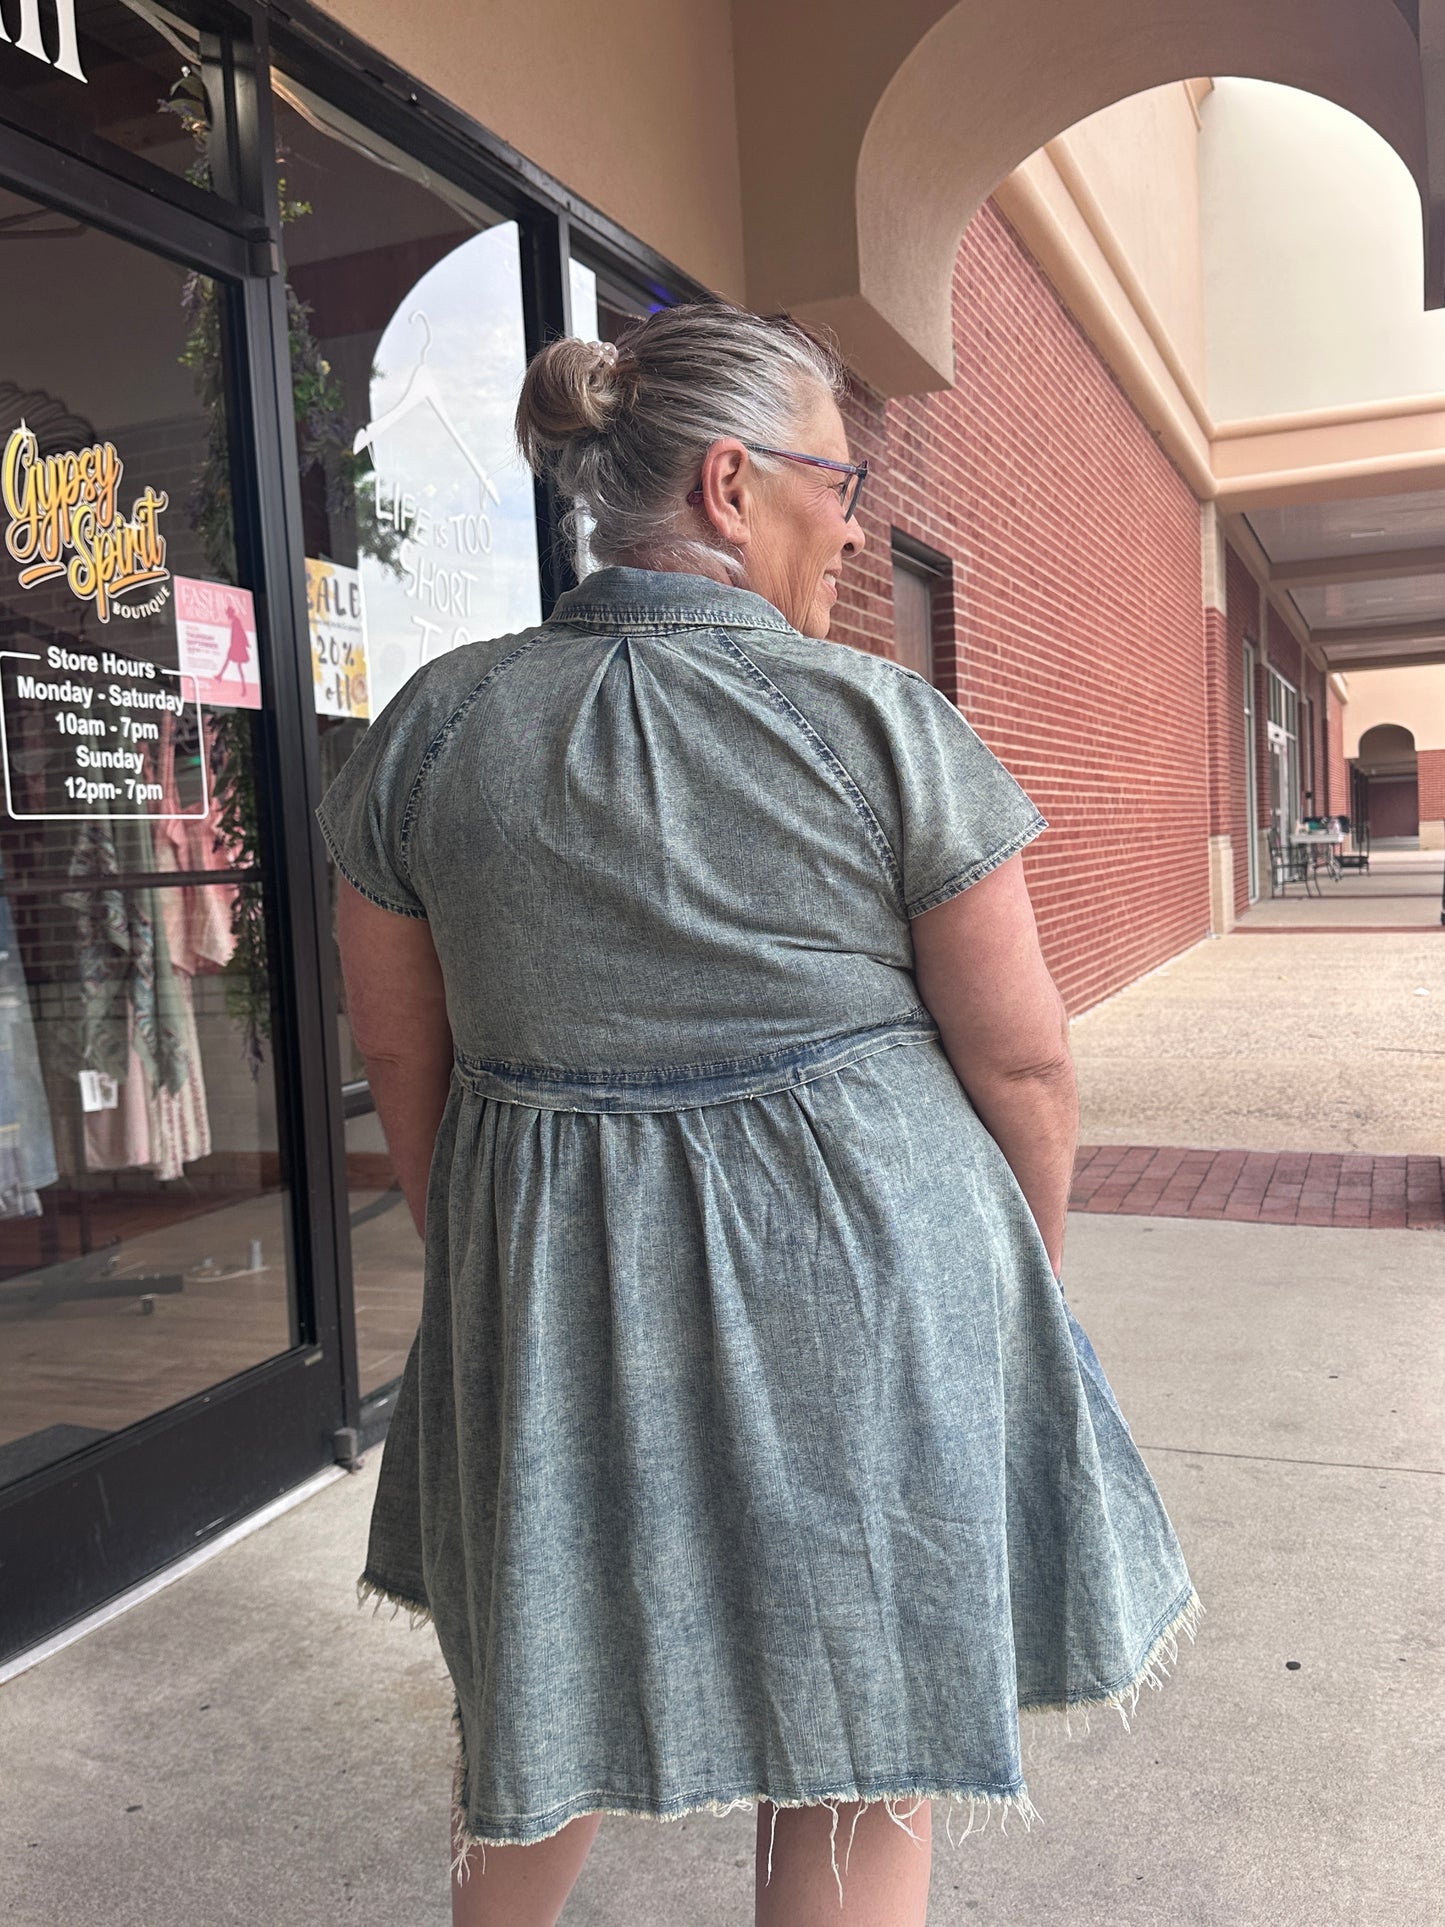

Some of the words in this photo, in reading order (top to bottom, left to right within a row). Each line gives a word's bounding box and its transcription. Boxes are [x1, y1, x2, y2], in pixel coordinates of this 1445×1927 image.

[2, 417, 124, 563] Gypsy
[375, 475, 431, 548] LIFE
[431, 522, 449, 549] IS
[448, 513, 493, 555] TOO
[67, 485, 169, 624] Spirit
[399, 538, 479, 617] SHORT
[112, 585, 172, 619] BOUTIQUE
[47, 646, 99, 673] Store
[102, 652, 157, 679] Hours
[316, 634, 355, 667] 20%
[16, 675, 94, 709] Monday
[108, 684, 185, 717] Saturday
[55, 711, 106, 737] 10am
[119, 716, 159, 744] 7pm
[75, 744, 145, 774] Sunday
[124, 778, 163, 805] 7pm
